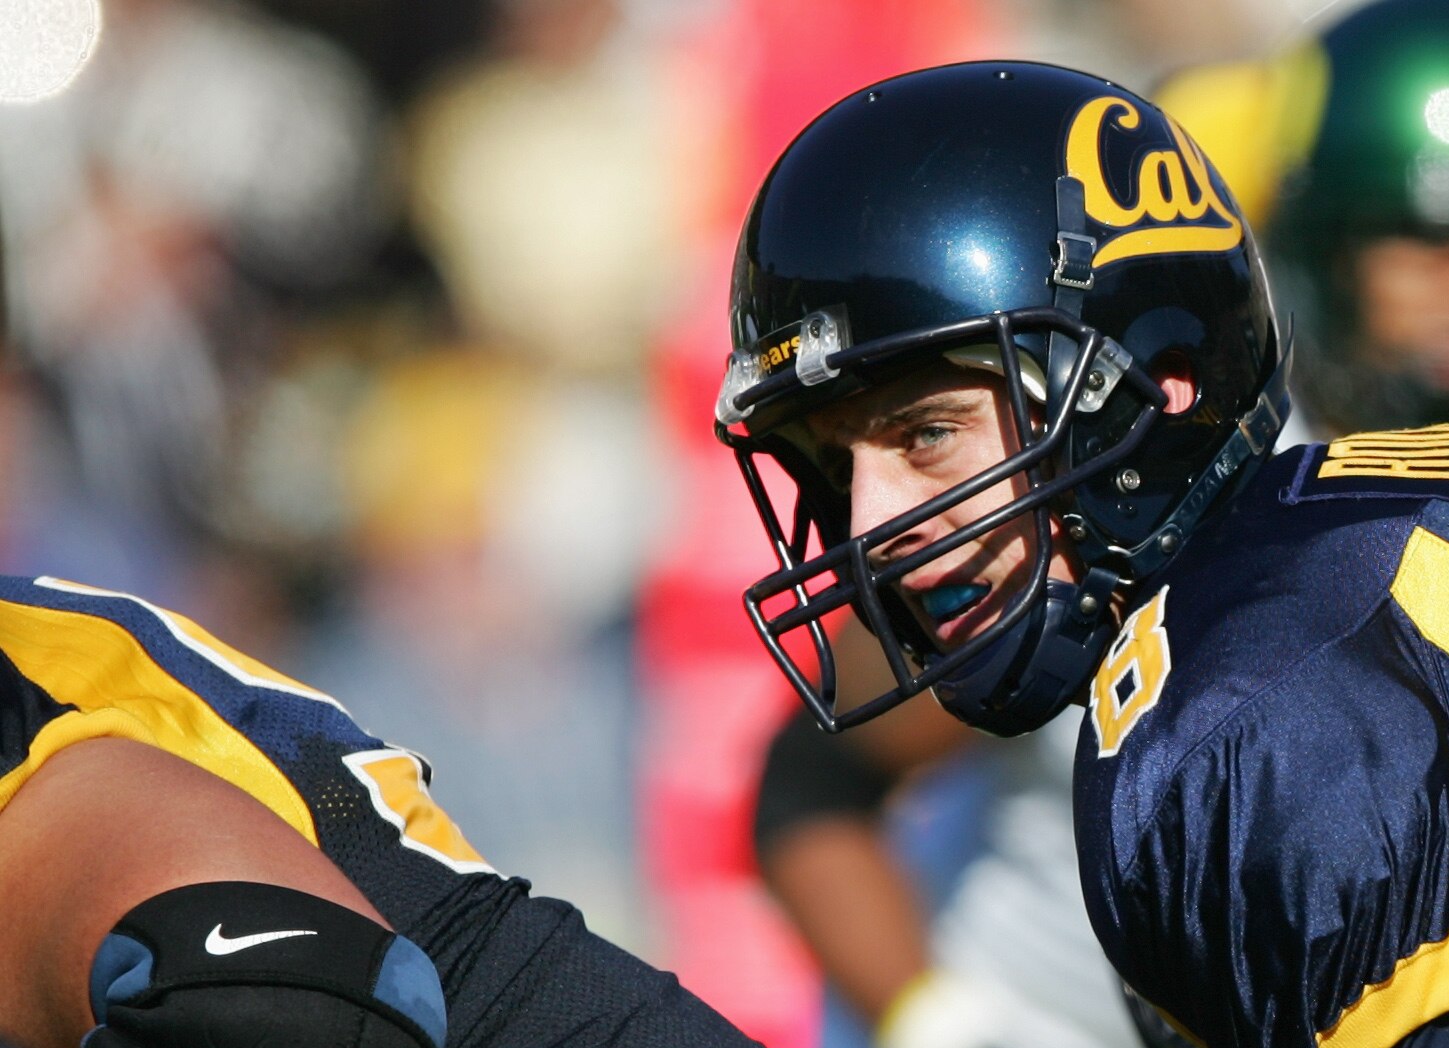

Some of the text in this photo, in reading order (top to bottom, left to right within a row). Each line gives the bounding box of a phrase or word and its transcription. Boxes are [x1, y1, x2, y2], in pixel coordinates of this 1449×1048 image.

[1065, 96, 1243, 268] Cal
[755, 335, 802, 371] ears
[1089, 584, 1172, 759] 8
